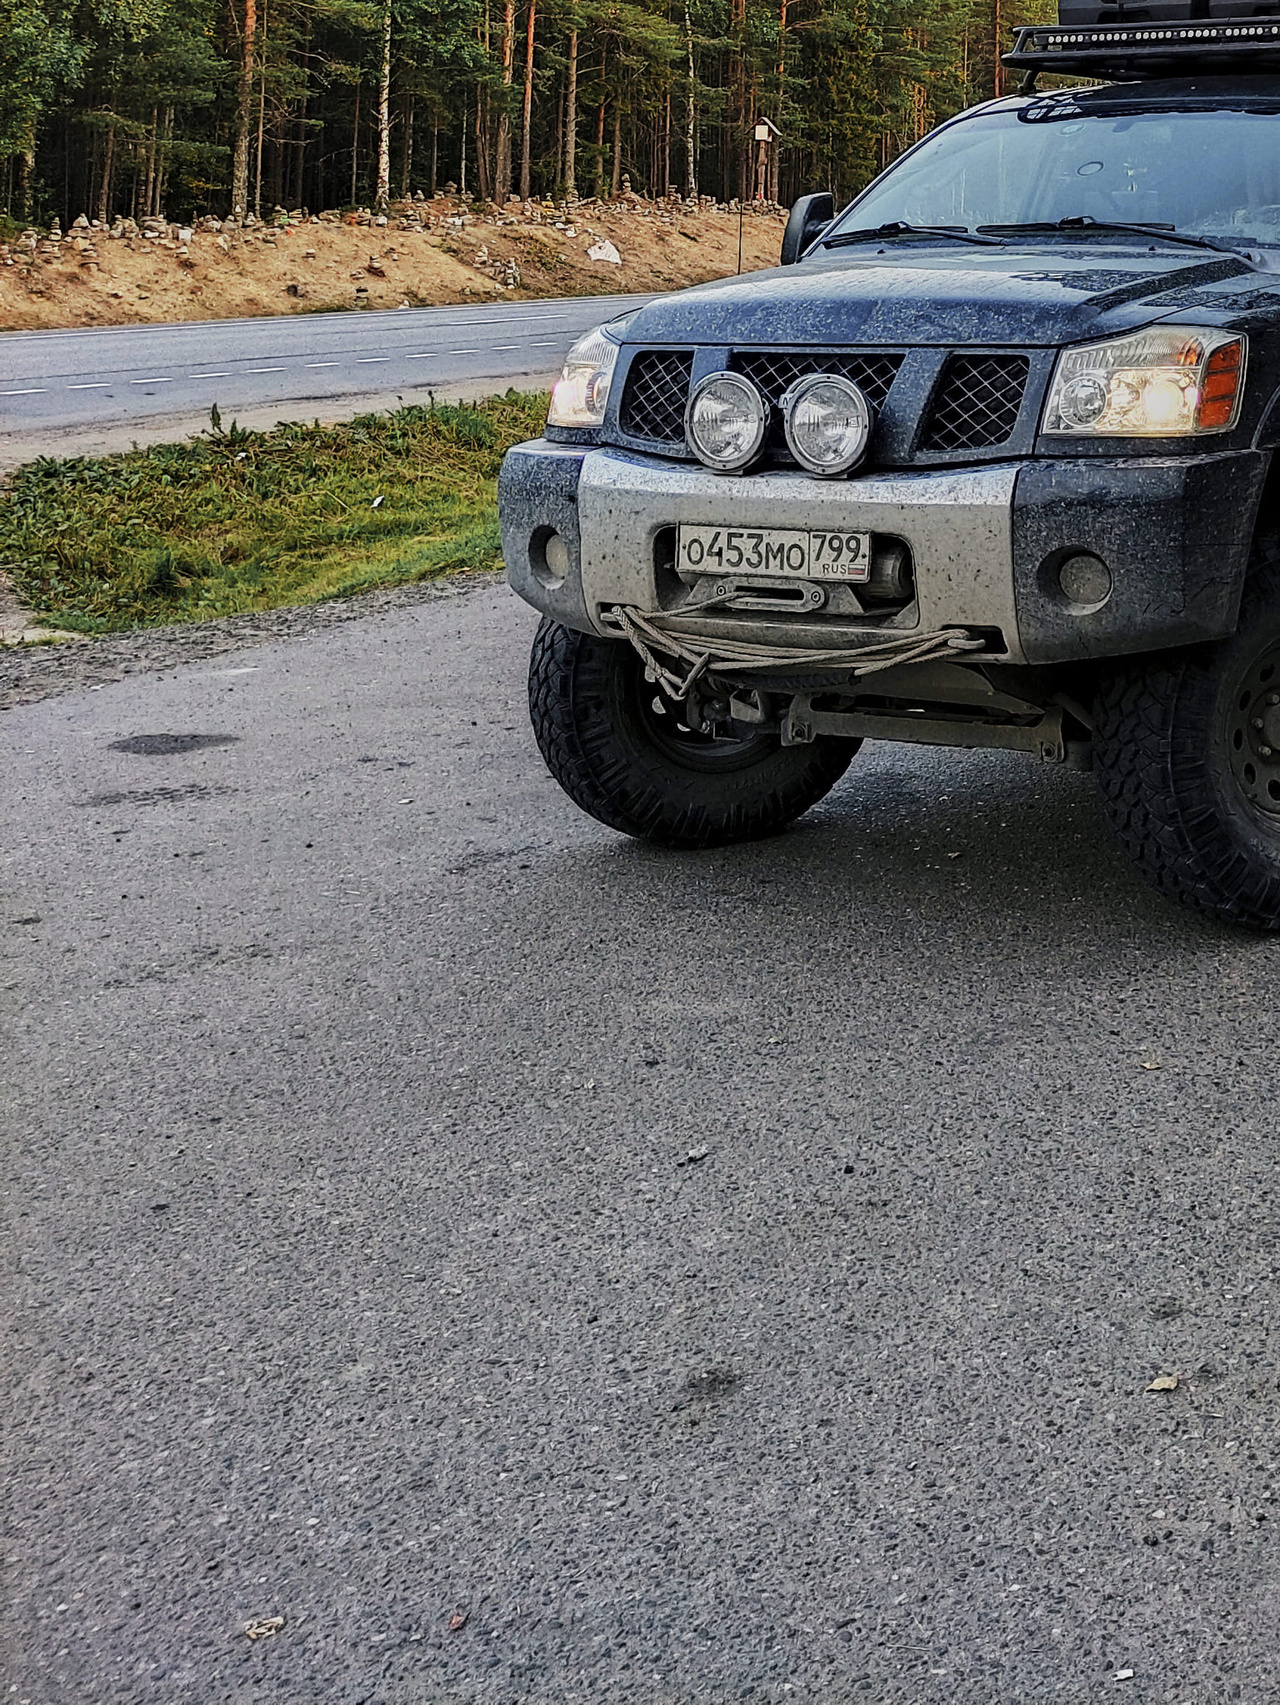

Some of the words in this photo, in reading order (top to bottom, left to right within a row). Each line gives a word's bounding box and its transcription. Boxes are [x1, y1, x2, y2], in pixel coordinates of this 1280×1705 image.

[686, 531, 806, 571] О453МО
[811, 533, 862, 564] 799
[822, 563, 847, 575] RUS
